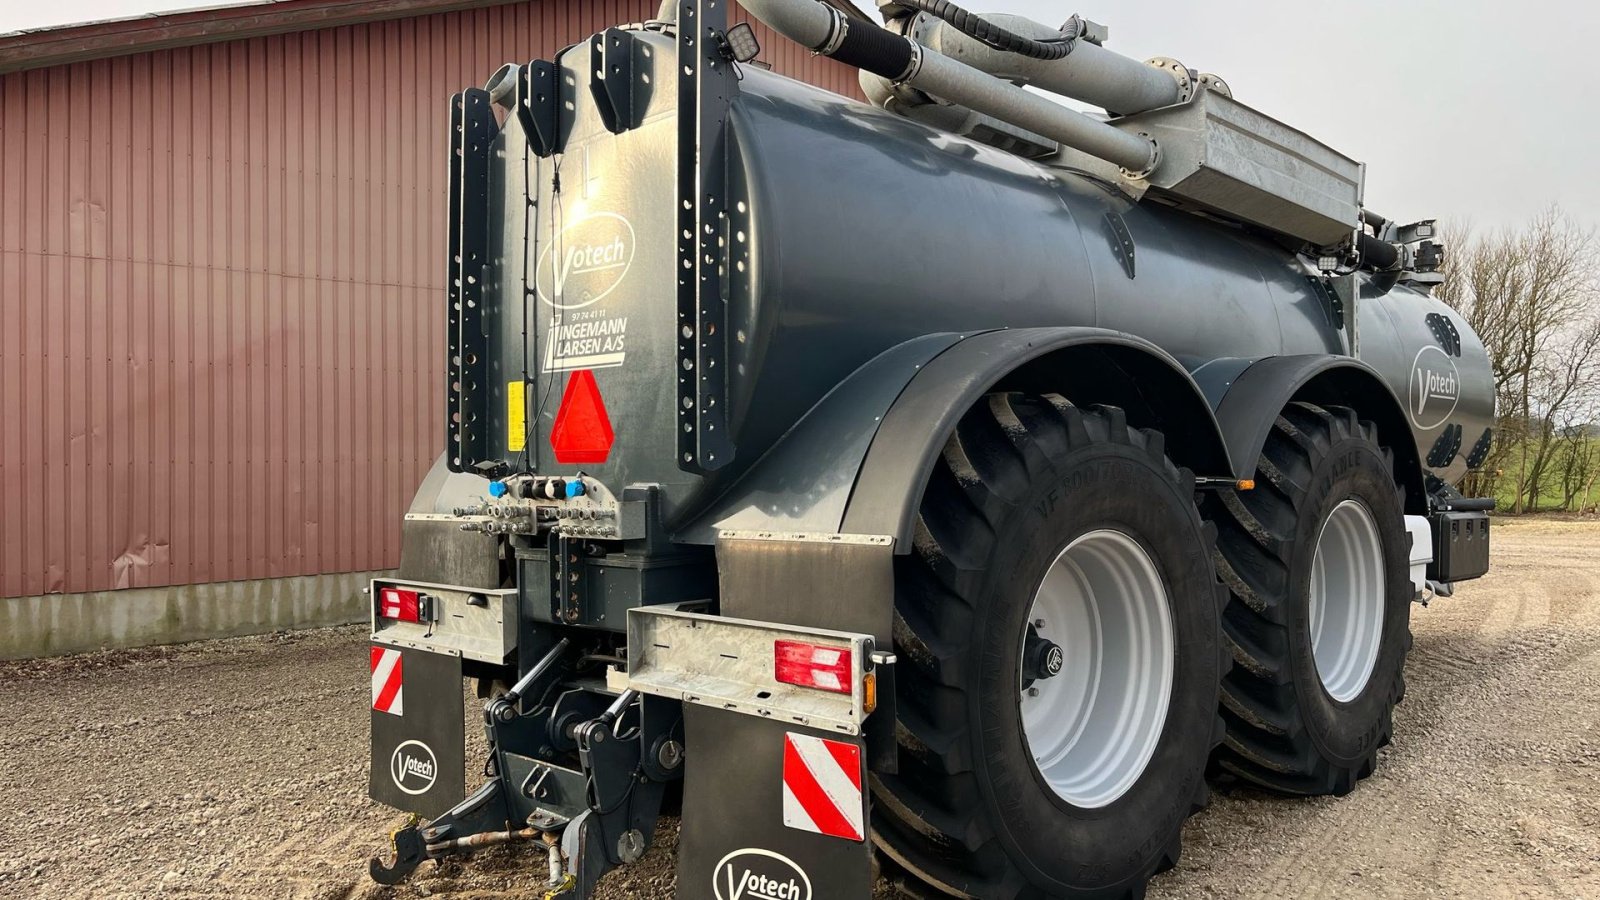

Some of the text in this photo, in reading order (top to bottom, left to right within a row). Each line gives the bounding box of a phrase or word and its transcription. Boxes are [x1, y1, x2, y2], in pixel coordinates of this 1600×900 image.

[551, 236, 625, 296] Votech
[571, 313, 580, 321] 97
[581, 312, 589, 320] 74
[590, 310, 597, 318] 41
[556, 334, 625, 357] LARSEN A/S
[1417, 367, 1456, 415] Votech
[397, 751, 433, 782] Votech
[727, 863, 800, 900] Votech
